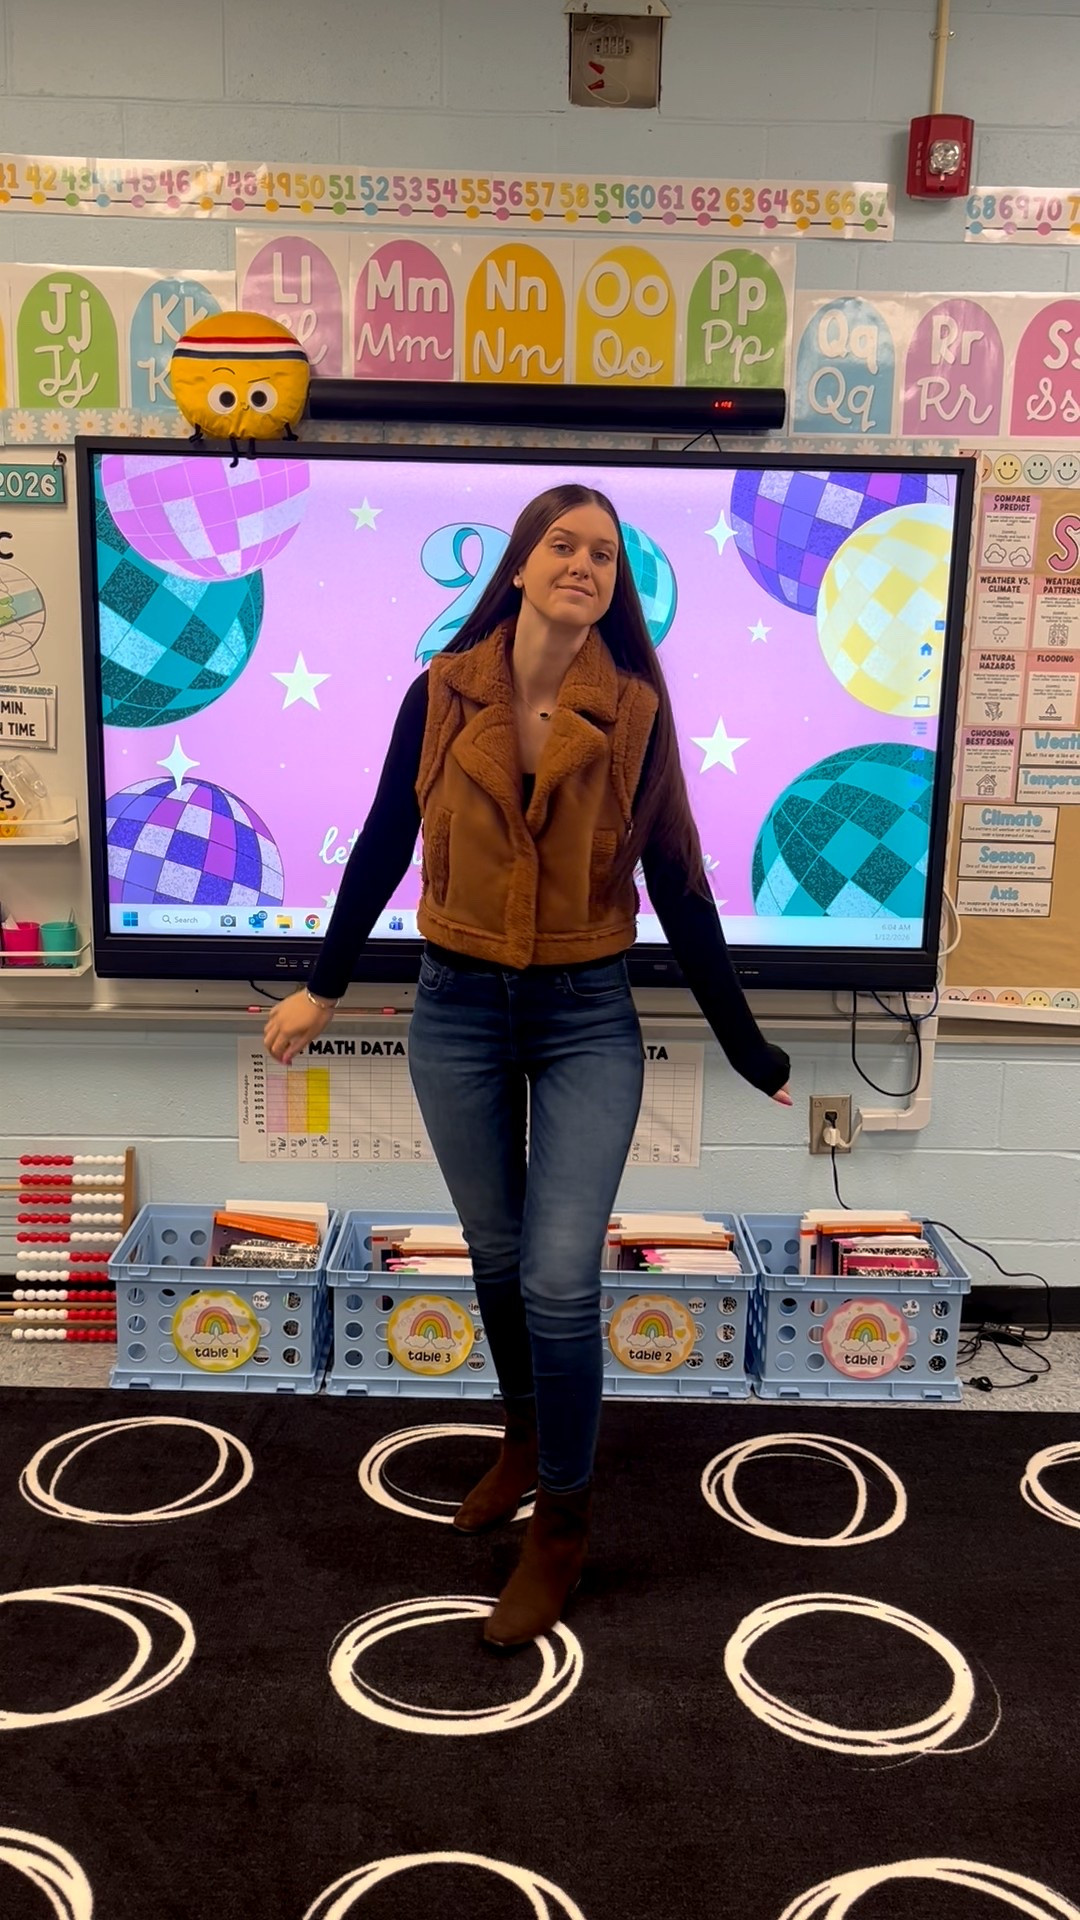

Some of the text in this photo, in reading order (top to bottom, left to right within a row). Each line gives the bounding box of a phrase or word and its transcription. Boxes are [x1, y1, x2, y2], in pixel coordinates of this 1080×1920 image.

[26, 164, 57, 190] 42
[60, 166, 91, 191] 43
[125, 168, 157, 193] 45
[160, 169, 190, 195] 46
[227, 170, 257, 196] 48
[260, 171, 291, 198] 49
[294, 172, 325, 199] 50
[328, 174, 356, 200] 51
[359, 175, 390, 201] 52
[392, 176, 423, 202] 53
[426, 177, 457, 203] 54
[461, 178, 491, 206] 55
[492, 180, 523, 207] 56
[525, 181, 555, 208] 57
[560, 182, 590, 208] 58
[594, 183, 625, 208] 59
[628, 184, 657, 210] 60
[659, 184, 685, 210] 61
[691, 185, 721, 212] 62
[725, 187, 755, 213] 63
[757, 188, 788, 213] 64
[790, 189, 820, 215] 65
[824, 190, 856, 216] 66
[860, 191, 889, 217] 67
[966, 195, 1080, 221] 68 69 70 7
[367, 259, 448, 313] Mm
[485, 259, 548, 311] Nn
[585, 260, 669, 318] Oo
[710, 260, 767, 326] Pp
[41, 283, 93, 351] Jj
[356, 322, 453, 362] Mm
[817, 308, 879, 375] Qq
[930, 313, 984, 366] Rr
[1042, 319, 1080, 370] S
[472, 326, 564, 378] Nn
[592, 328, 664, 379] Oo
[701, 319, 775, 383] Pp
[34, 345, 99, 409] Jj
[808, 366, 877, 433] Qq
[916, 376, 993, 425] Rr
[994, 494, 1031, 503] COMPARE
[1000, 503, 1031, 512] PREDICT
[980, 576, 1030, 585] WEATHER VS.
[1045, 577, 1080, 586] WEATHER
[988, 585, 1021, 593] CLIMATE
[1043, 586, 1080, 594] PATTERNS
[979, 662, 1015, 670] HAZARDS
[980, 654, 1015, 662] NATURAL
[1037, 654, 1074, 663] FLOODING
[1, 701, 27, 716] MIN.
[8, 722, 36, 737] TIME
[970, 729, 1010, 738] CHOOSING
[965, 737, 1014, 746] BEST DESIGN
[981, 808, 1043, 827] Climate
[979, 845, 1036, 864] Season
[990, 885, 1020, 901] Axis
[174, 916, 198, 924] Search
[309, 1040, 406, 1056] MATH DATA
[195, 1348, 239, 1358] table 4
[408, 1350, 451, 1363] table 3
[628, 1349, 672, 1362] table 2
[844, 1354, 885, 1366] table 1
